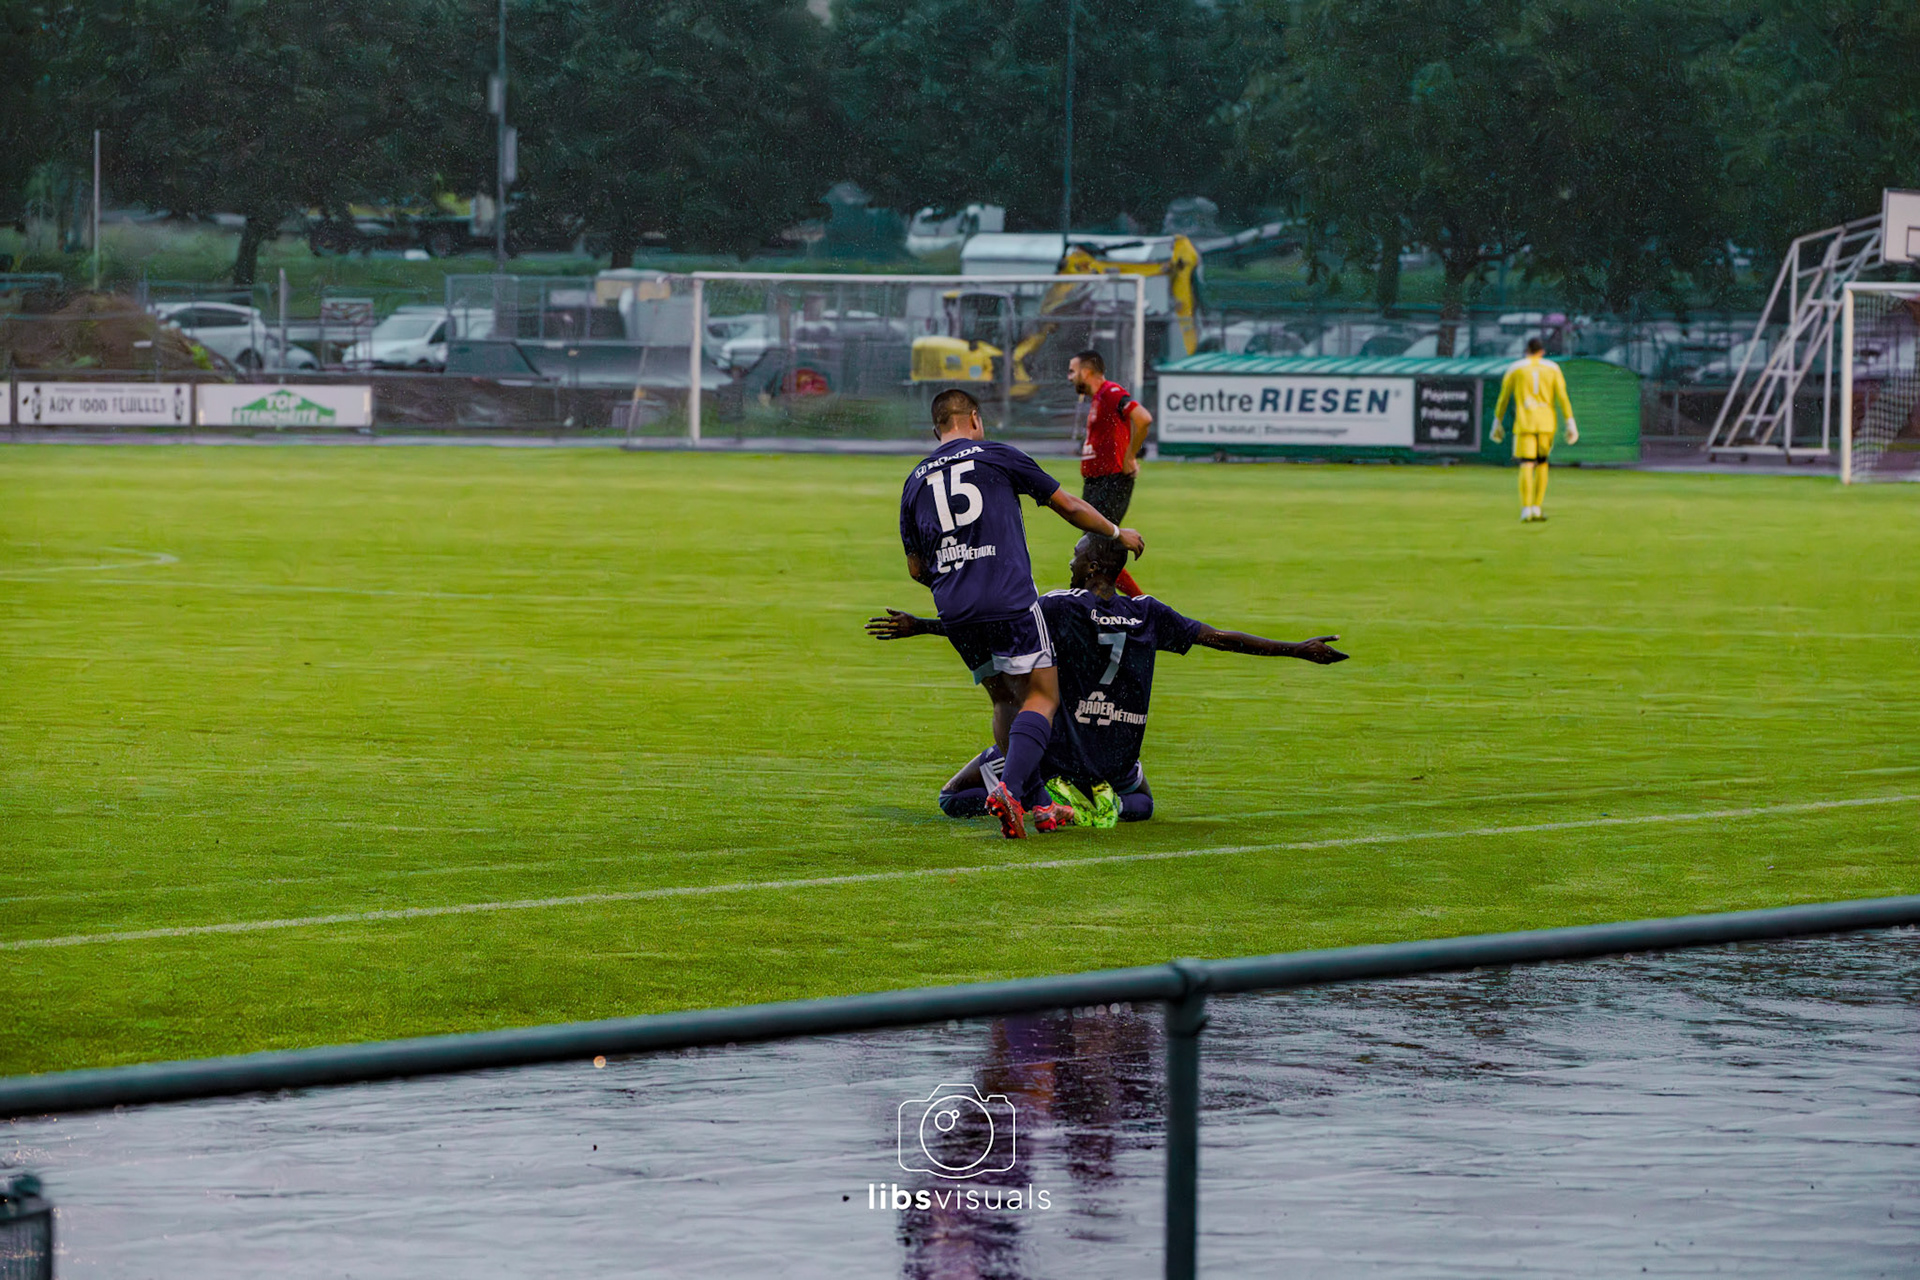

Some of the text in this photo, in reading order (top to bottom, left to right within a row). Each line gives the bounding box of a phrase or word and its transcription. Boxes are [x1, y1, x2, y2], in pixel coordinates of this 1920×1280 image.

[79, 397, 107, 413] 1000
[264, 395, 302, 410] TOP
[1166, 388, 1390, 414] centre RIESEN
[927, 446, 984, 469] HONDA
[925, 459, 983, 533] 15
[1098, 632, 1126, 685] 7
[1078, 699, 1115, 716] BADER
